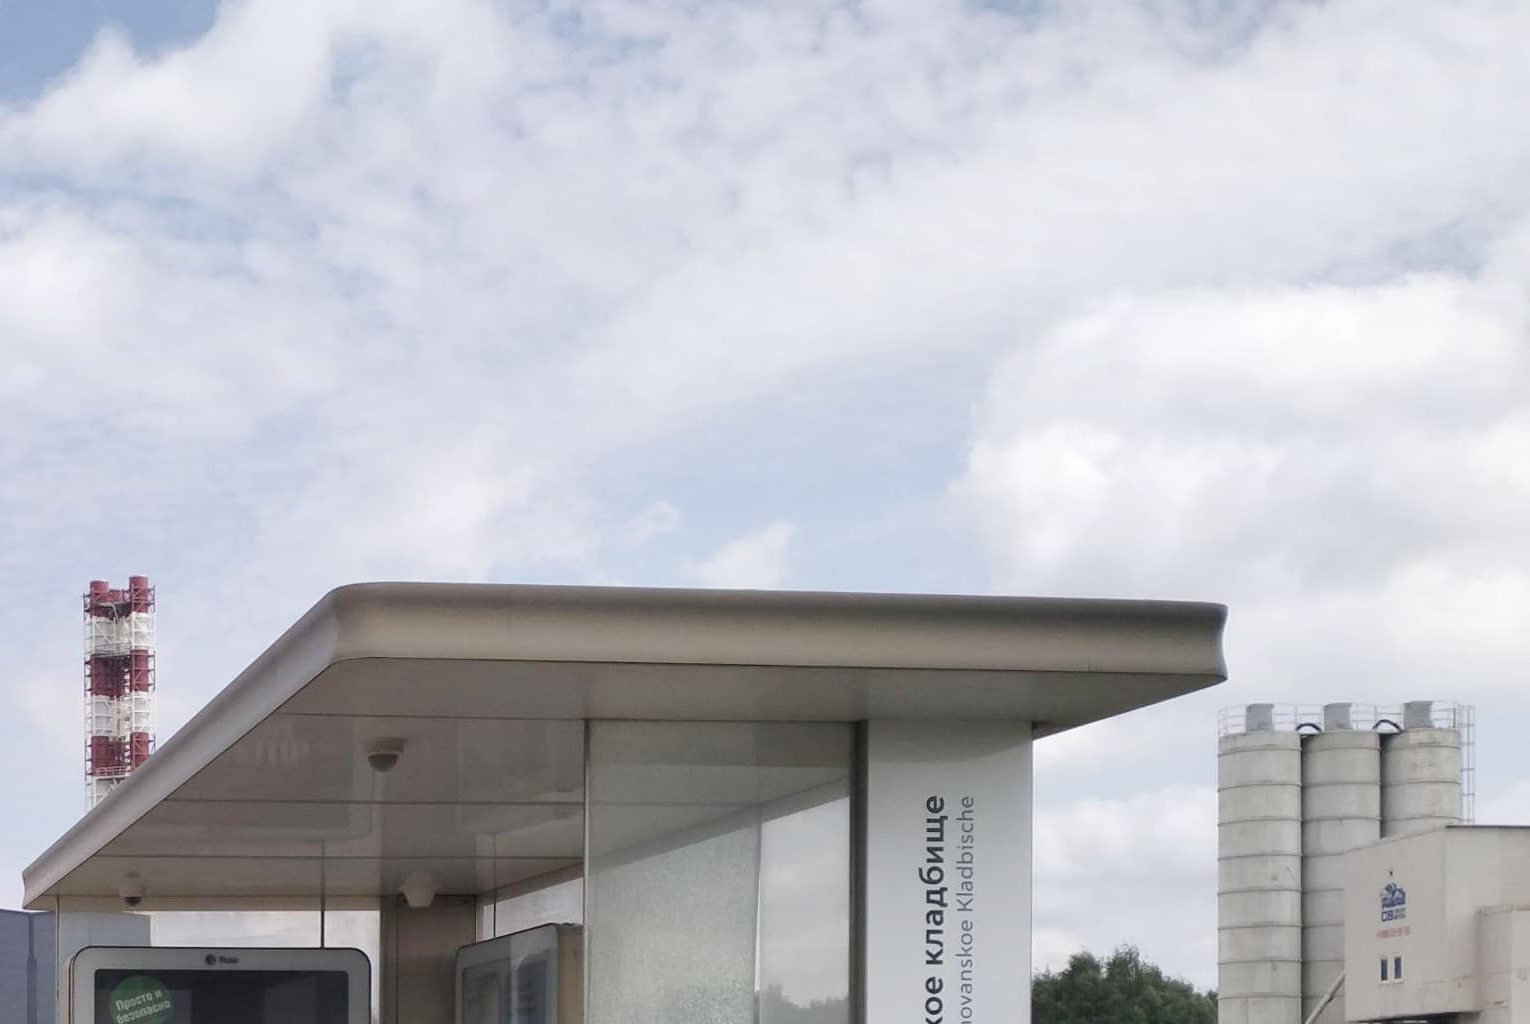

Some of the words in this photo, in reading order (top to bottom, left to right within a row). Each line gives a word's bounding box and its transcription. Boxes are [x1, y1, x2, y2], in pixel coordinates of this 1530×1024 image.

[919, 794, 948, 966] кладбище
[956, 795, 975, 913] Kladbische
[116, 992, 153, 1010] Просто
[116, 1000, 171, 1024] безопасно
